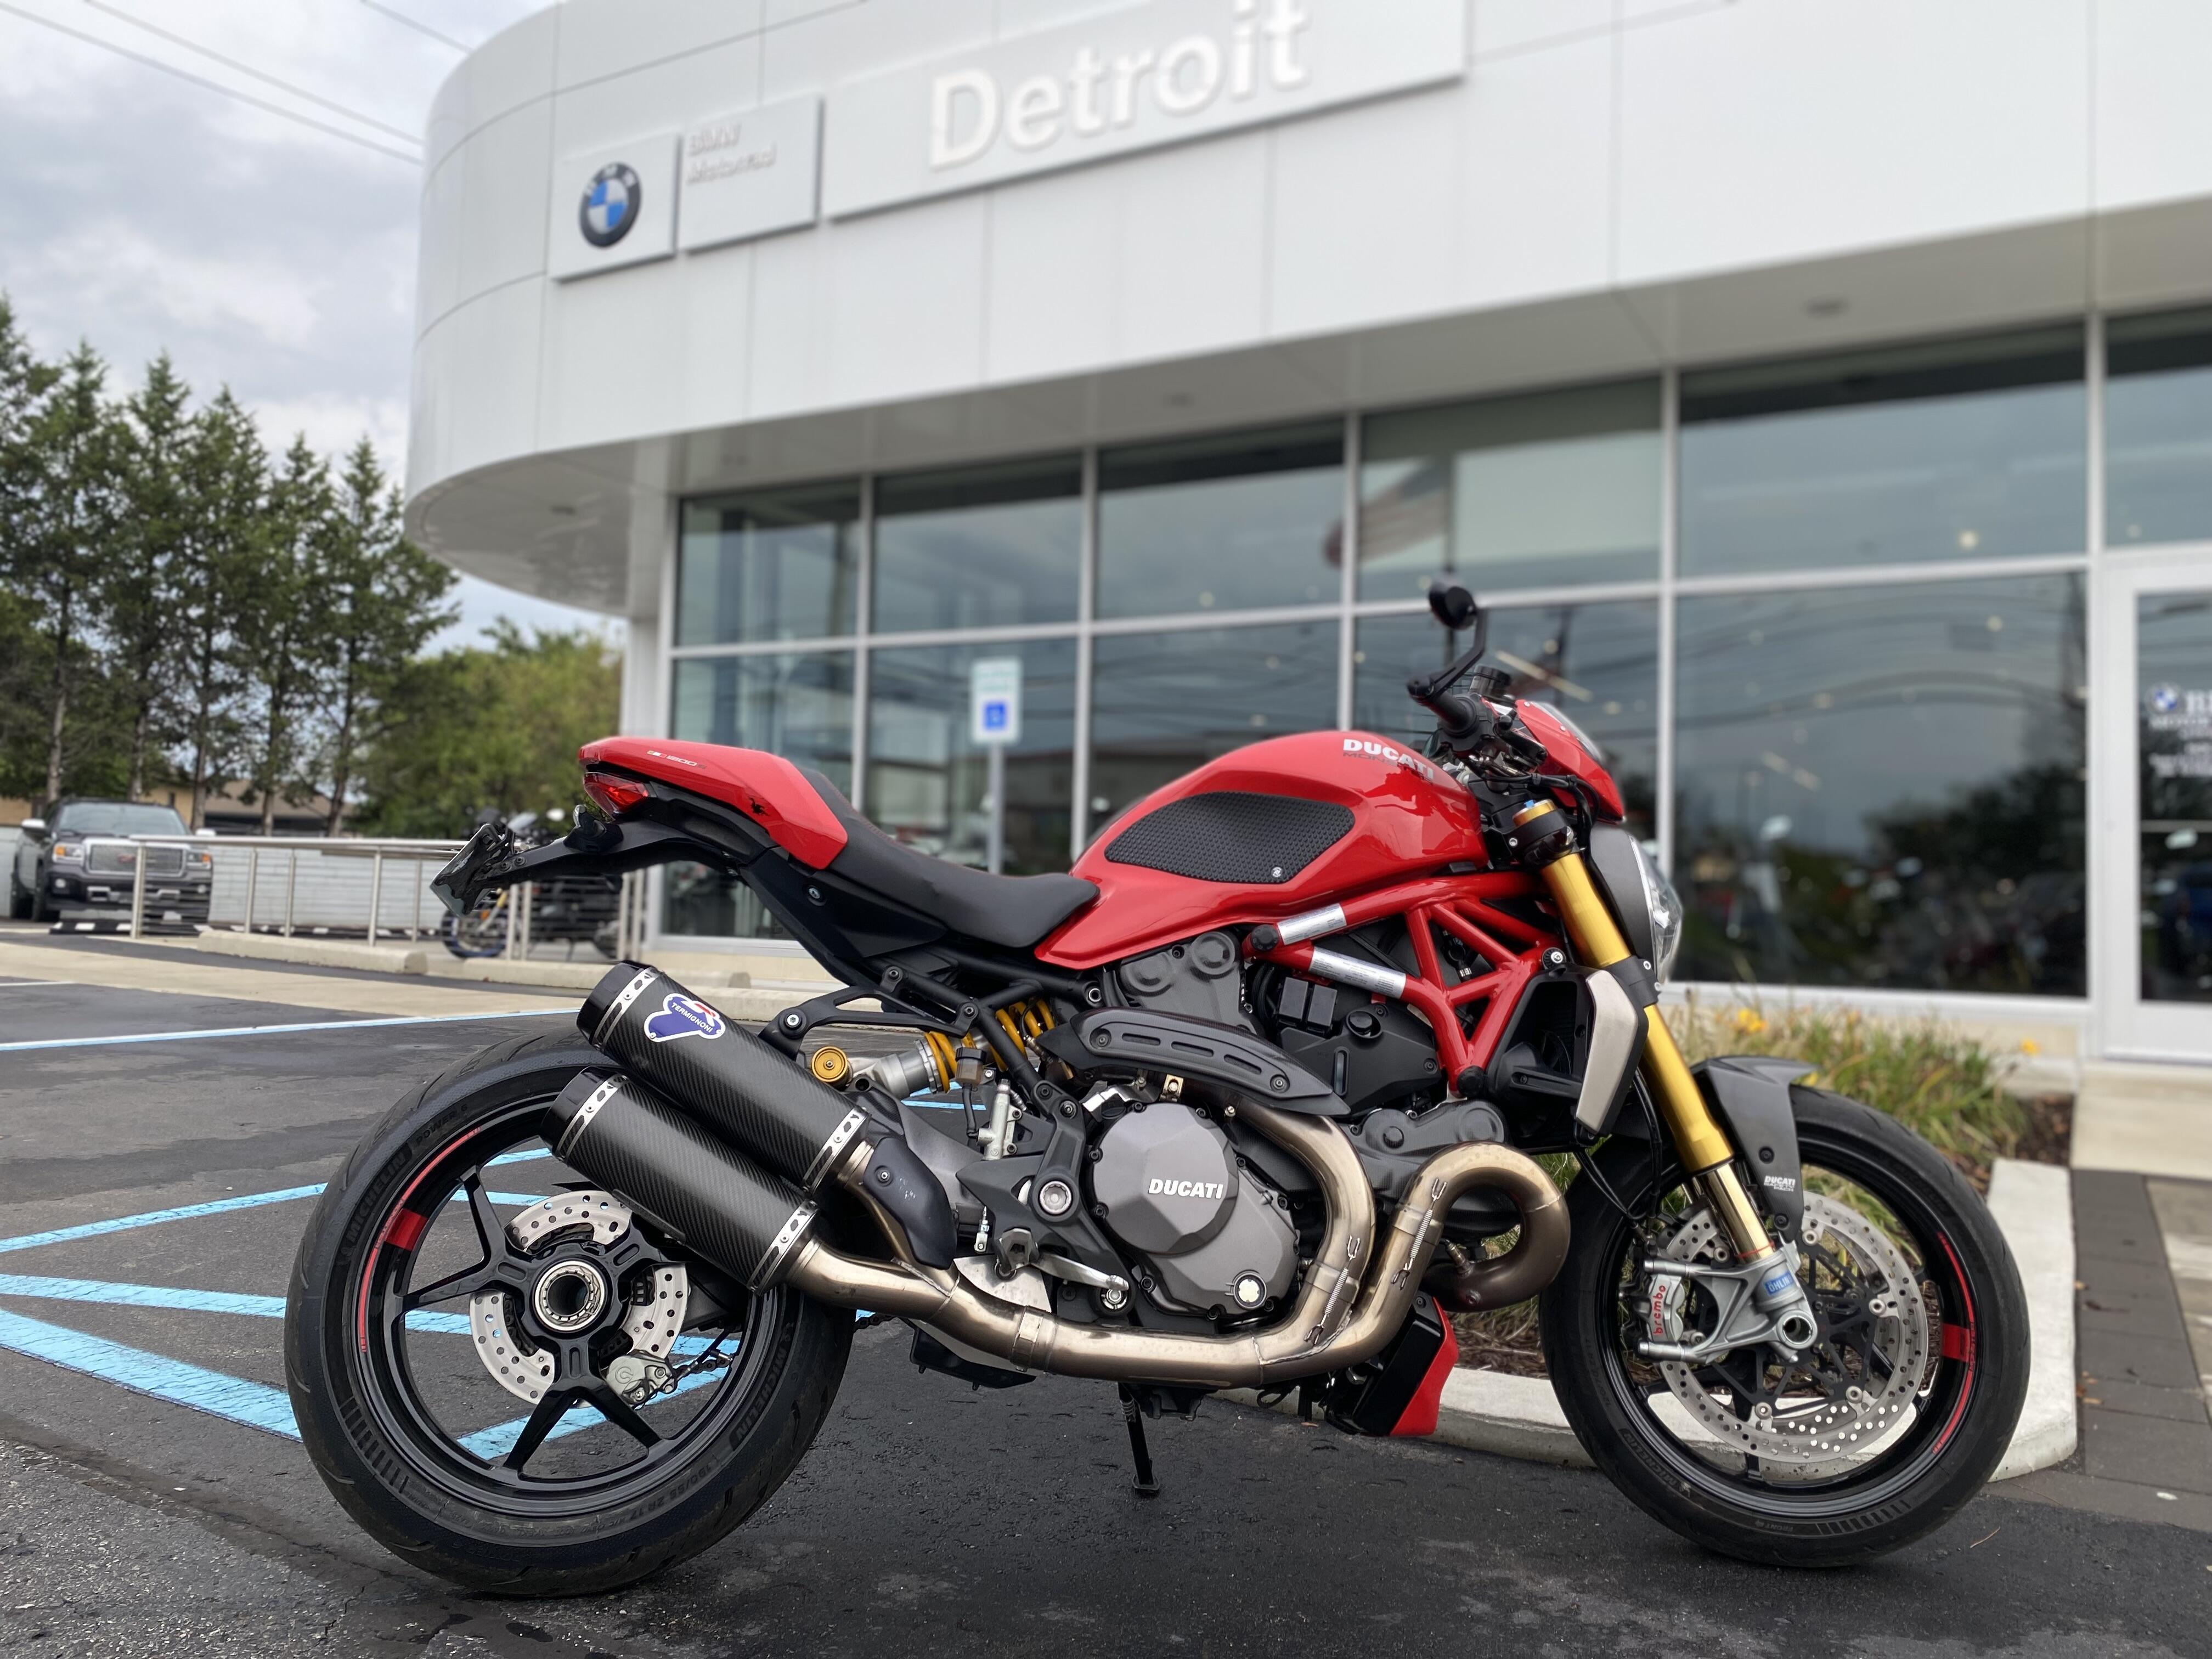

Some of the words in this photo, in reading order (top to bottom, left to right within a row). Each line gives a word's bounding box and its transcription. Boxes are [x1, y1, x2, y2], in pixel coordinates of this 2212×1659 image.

[932, 0, 1311, 170] Detroit
[1343, 738, 1434, 780] DUCATI
[671, 1002, 713, 1032] TERMIGNONI
[1148, 1178, 1224, 1199] DUCATI
[1765, 1175, 1796, 1186] DUCATI
[1652, 1285, 1666, 1335] brembo
[733, 1346, 787, 1441] MICHELIN
[1623, 1432, 1678, 1486] MICHELIN
[1765, 1523, 1793, 1532] FRONT
